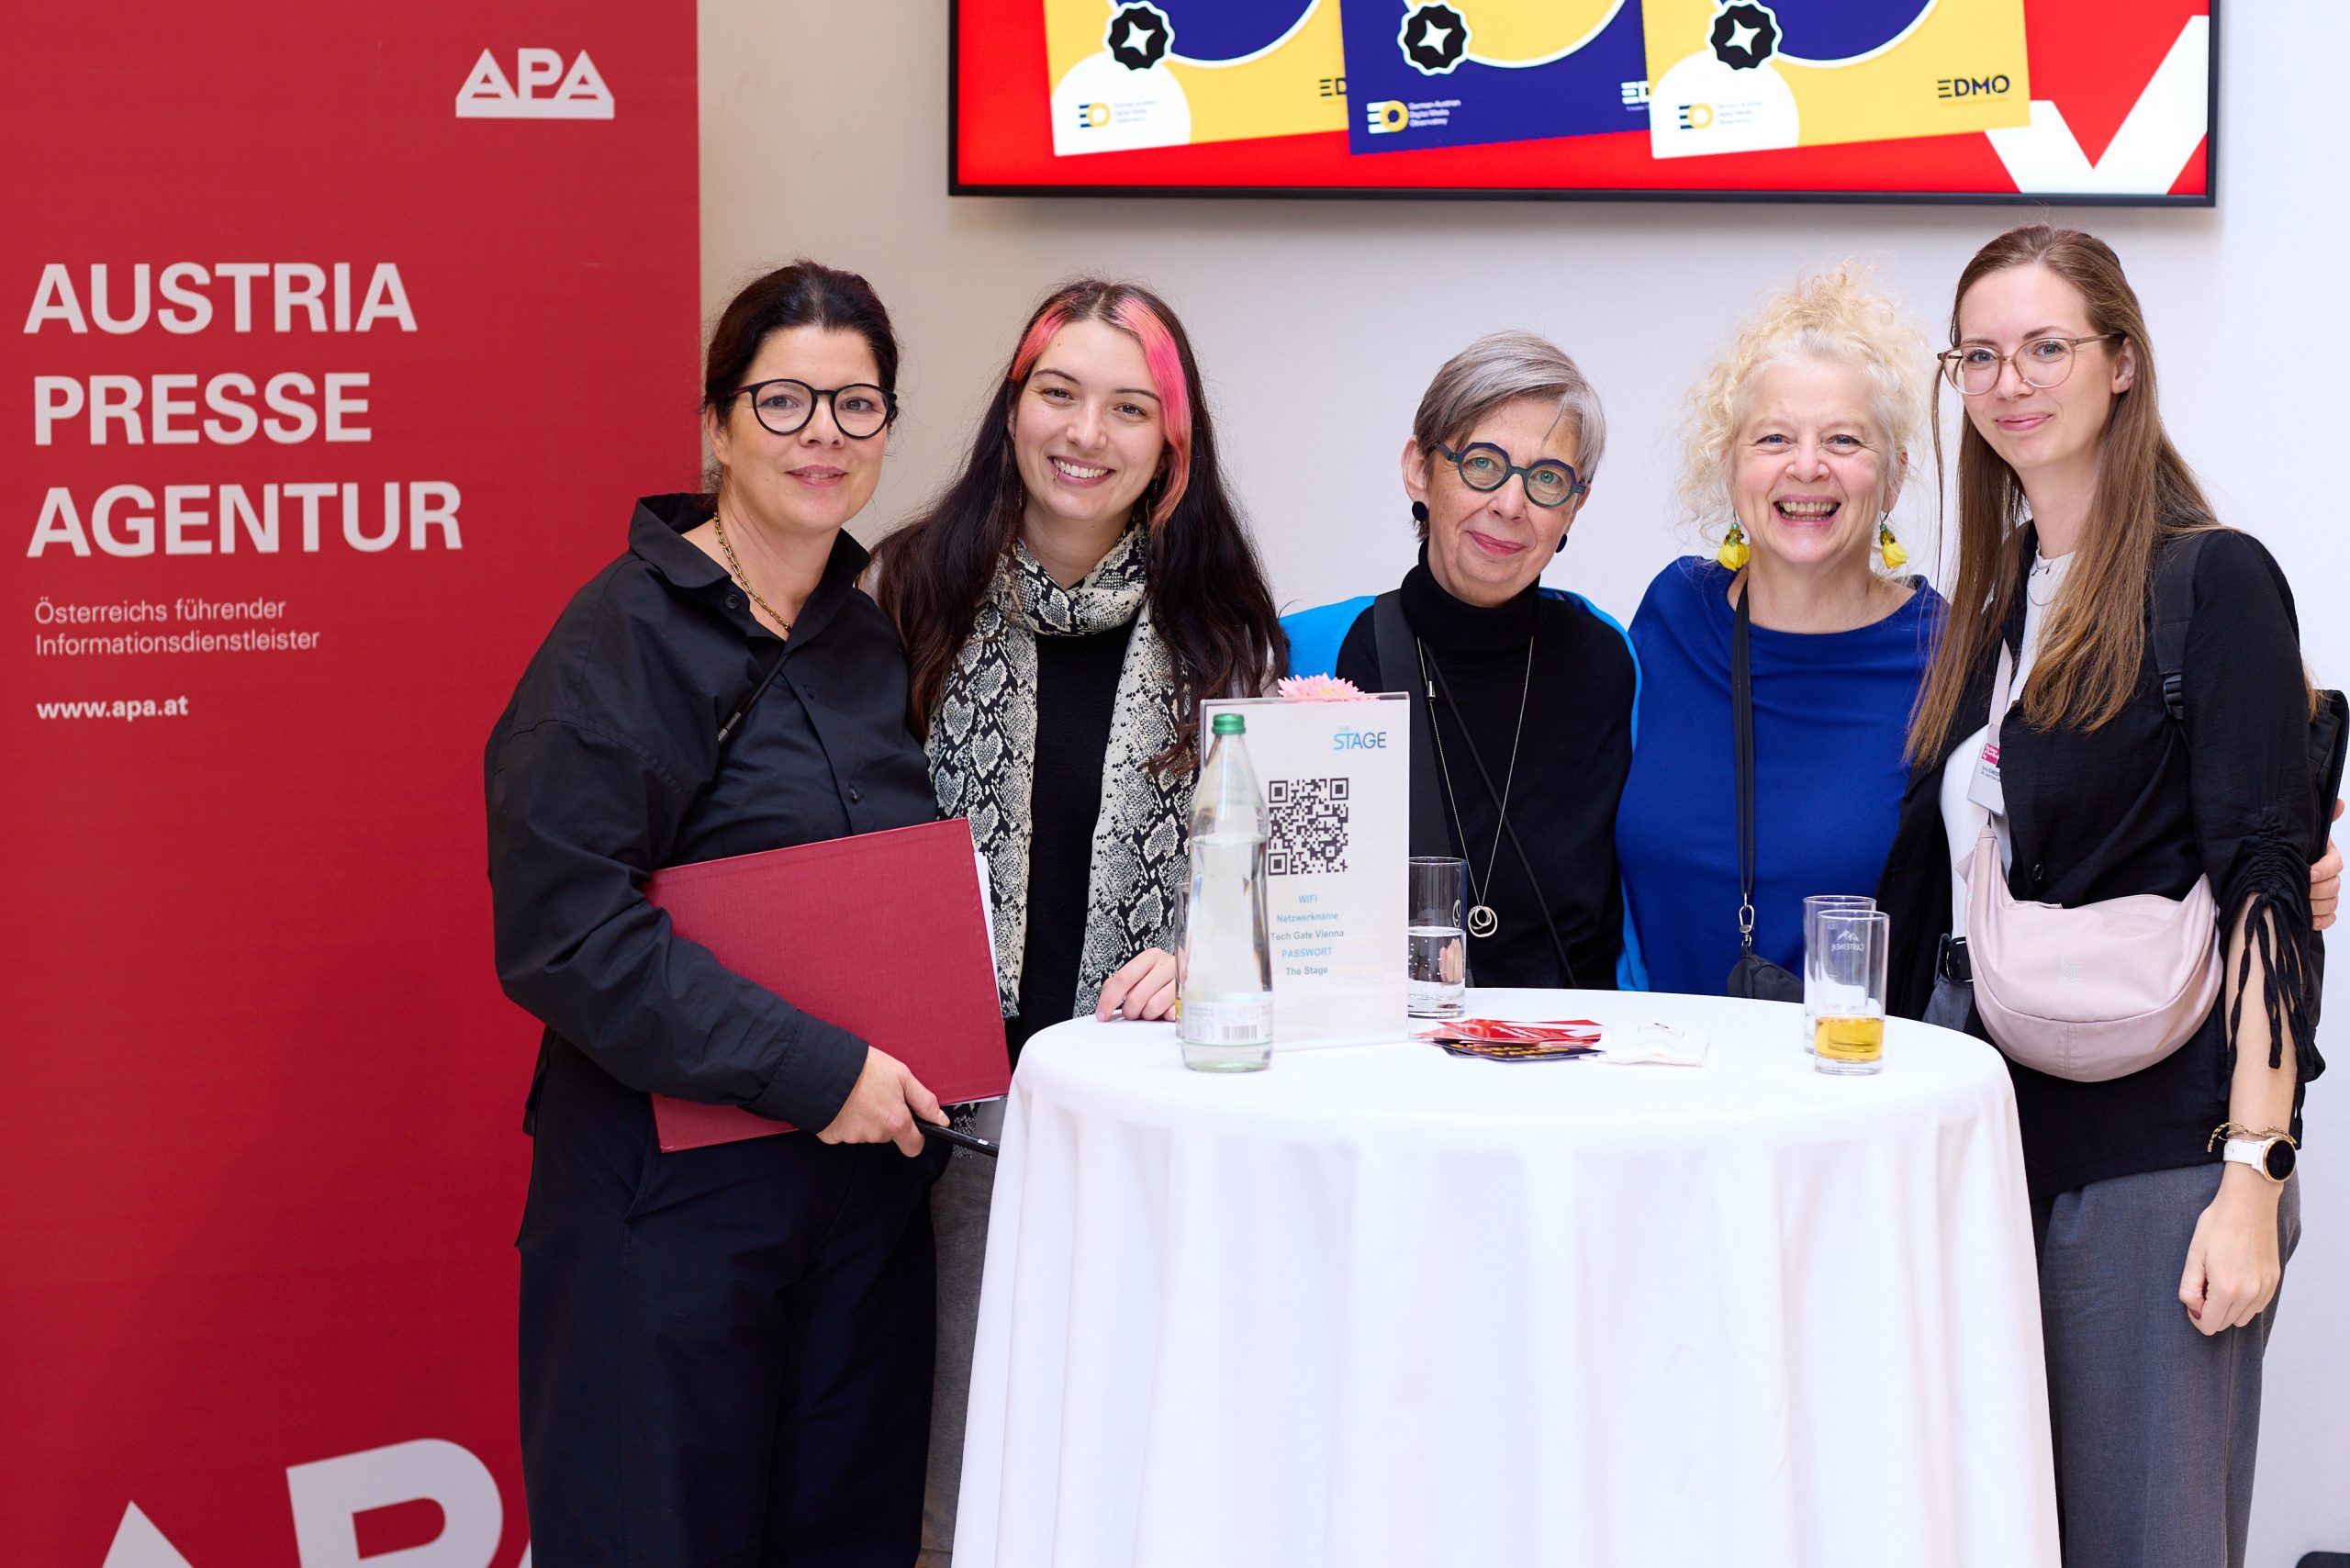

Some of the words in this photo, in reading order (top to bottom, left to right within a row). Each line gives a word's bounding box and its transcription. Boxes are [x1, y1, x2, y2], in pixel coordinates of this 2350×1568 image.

[455, 48, 614, 119] APA
[1937, 74, 2010, 98] EDMO
[23, 263, 418, 334] AUSTRIA
[34, 373, 371, 446] PRESSE
[26, 481, 463, 558] AGENTUR
[35, 597, 167, 624] Österreichs
[175, 598, 285, 621] führender
[36, 629, 319, 655] Informationsdienstleister
[36, 695, 188, 722] www.apa.at
[1333, 732, 1387, 750] STAGE
[1277, 912, 1338, 923] Netzwerkname
[1270, 932, 1292, 941] Tech
[1293, 931, 1313, 940] Gate
[1315, 929, 1344, 938] Vienna
[1281, 946, 1333, 958] PASSWORT
[1286, 967, 1302, 976] The
[1304, 966, 1328, 976] Stage
